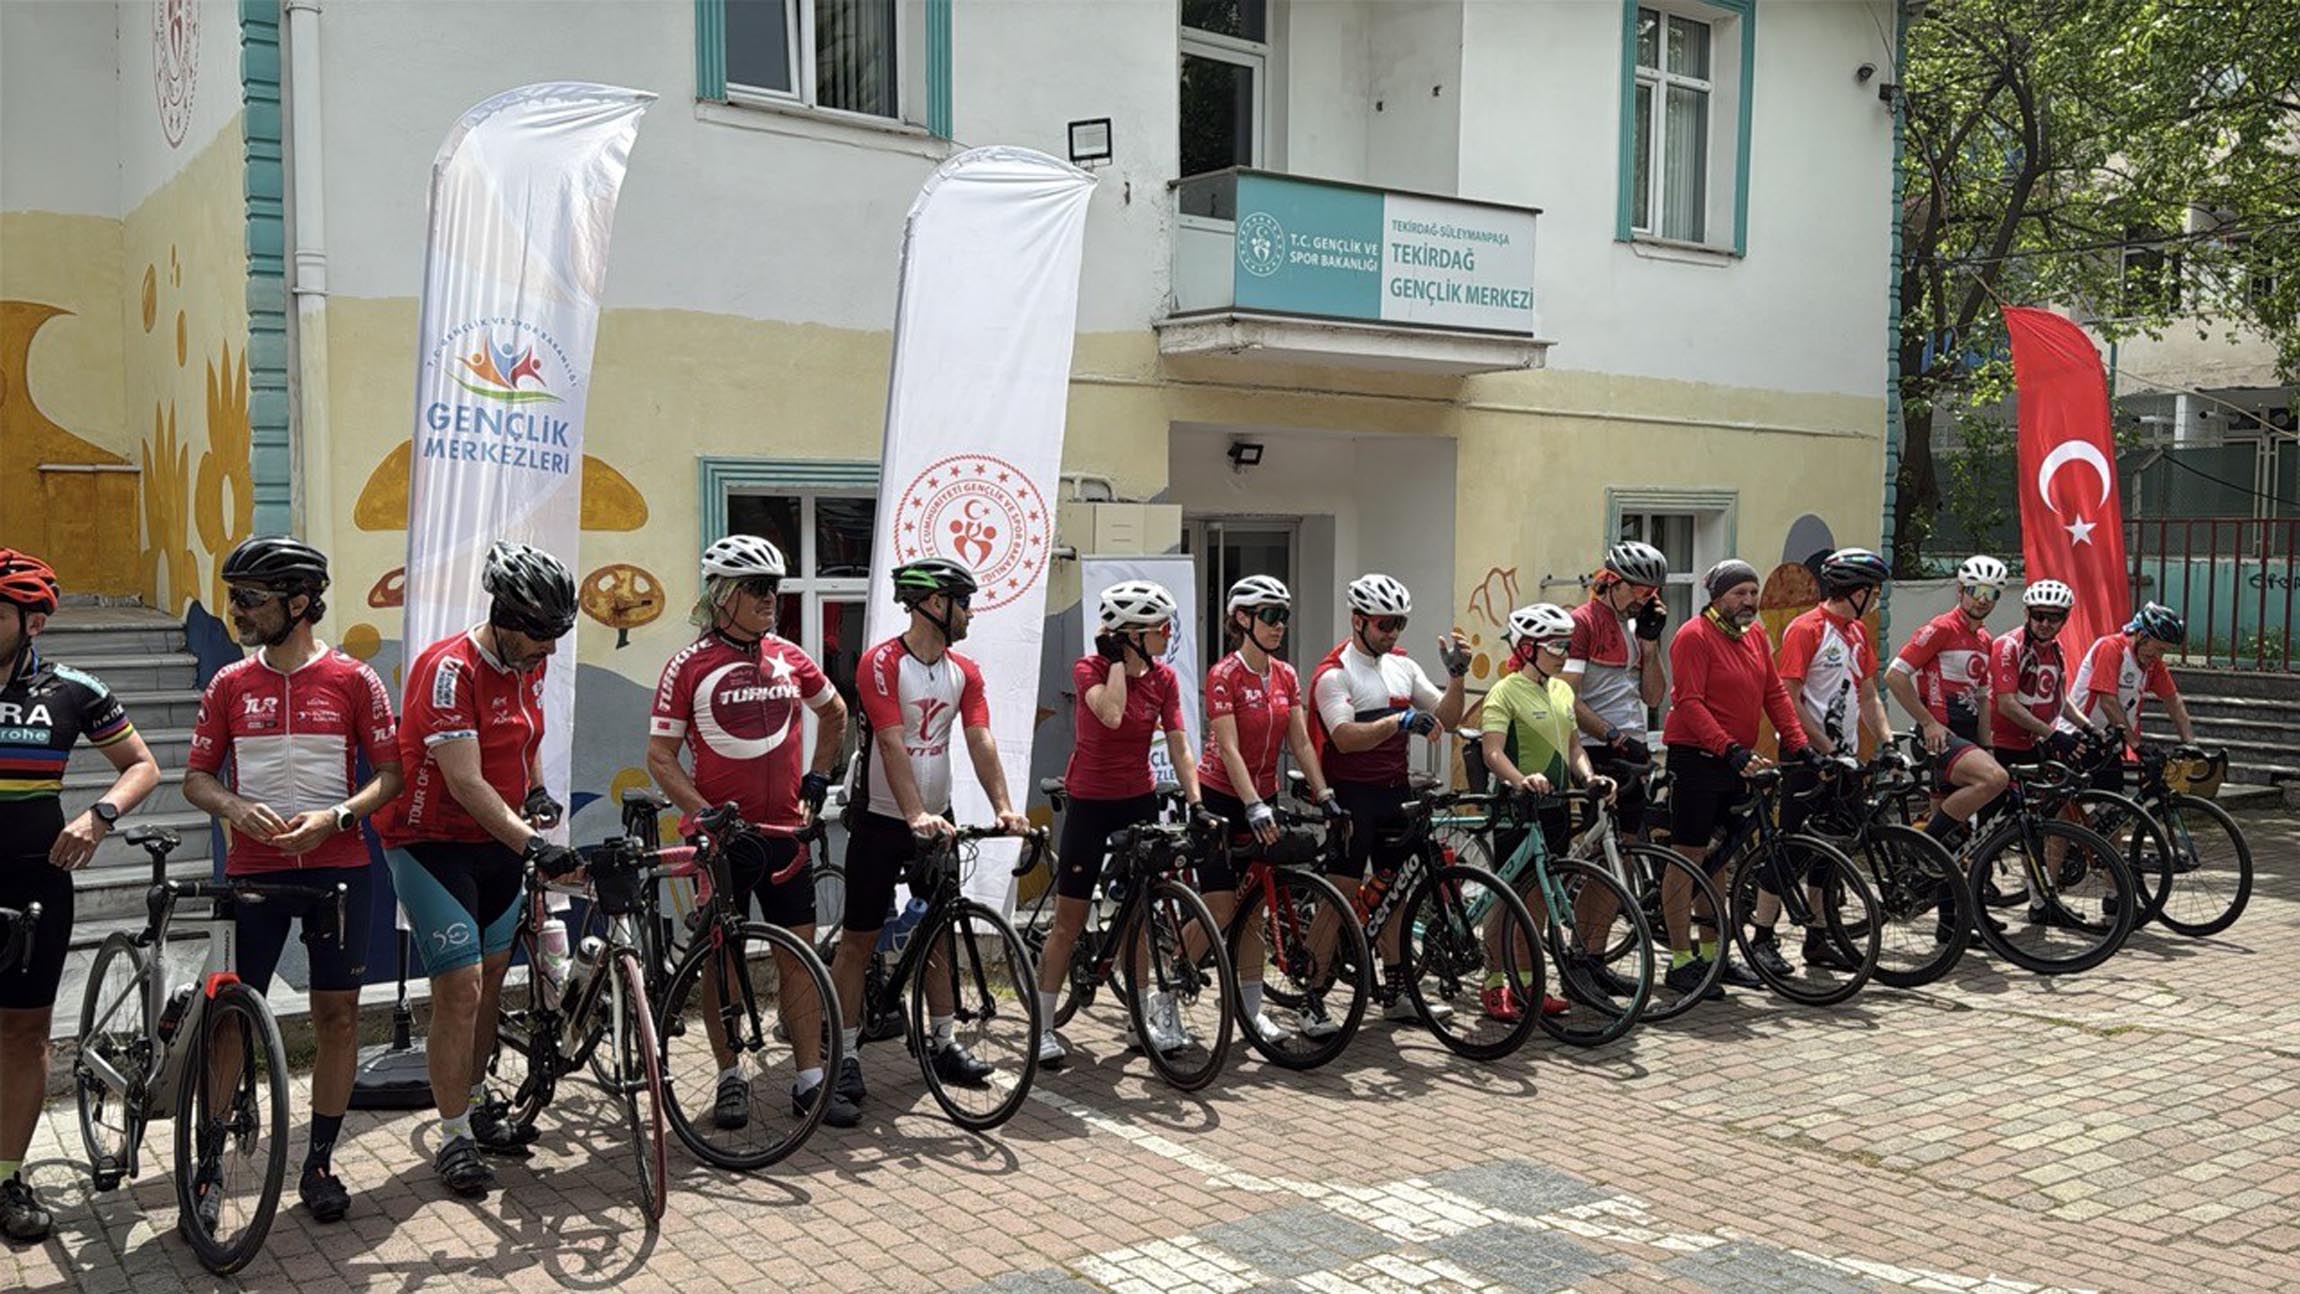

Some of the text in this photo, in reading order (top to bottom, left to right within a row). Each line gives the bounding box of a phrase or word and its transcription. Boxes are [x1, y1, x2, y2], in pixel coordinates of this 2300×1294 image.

[1289, 250, 1378, 272] SPOR BAKANLIĞI
[1290, 233, 1379, 256] T.C. GENÇLİK VE
[1391, 242, 1475, 271] TEKİRDAĞ
[1390, 277, 1534, 310] GENÇLİK MERKEZİ
[426, 402, 569, 448] GENÇLİK
[424, 437, 570, 475] MERKEZLERİ
[963, 482, 1006, 502] GENÇLİK
[1004, 500, 1015, 513] VE
[1013, 512, 1023, 540] SPOR
[417, 768, 431, 788] OF
[408, 790, 427, 826] TOUR
